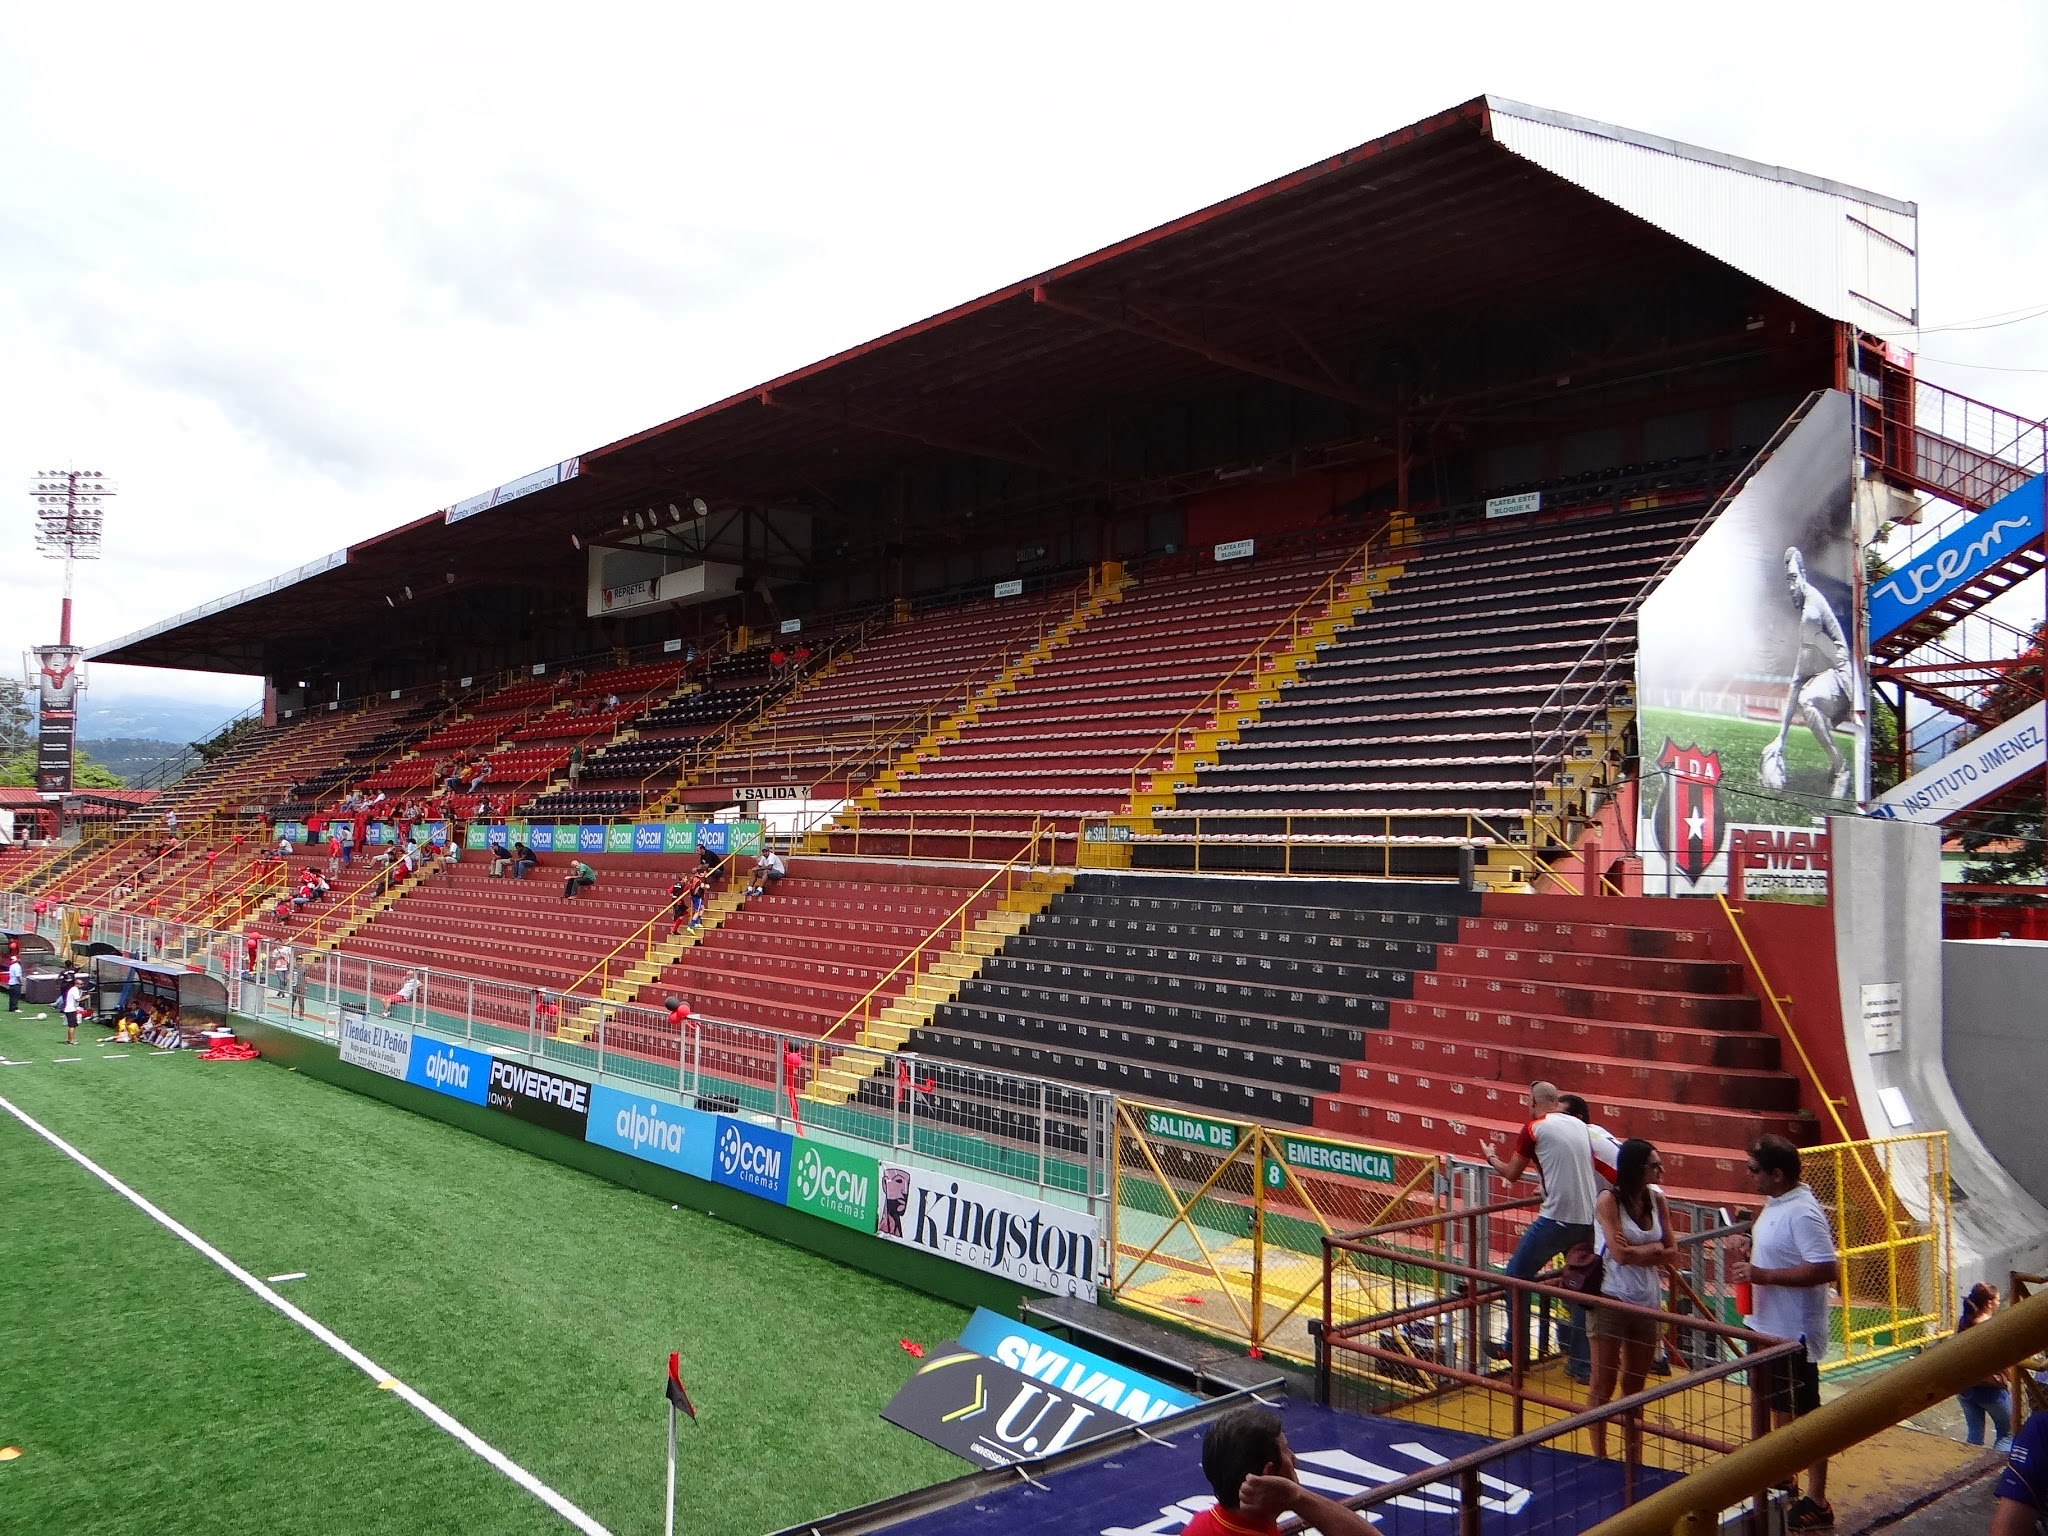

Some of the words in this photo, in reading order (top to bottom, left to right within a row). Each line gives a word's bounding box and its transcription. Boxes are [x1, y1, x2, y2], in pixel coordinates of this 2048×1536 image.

[1490, 498, 1516, 507] PLATEA
[1518, 494, 1536, 502] ESTE
[1494, 504, 1523, 514] BLOQUE
[1218, 544, 1236, 552] PLATEA
[1222, 550, 1242, 558] BLOQUE
[614, 582, 646, 599] REPRETEL
[1902, 764, 1978, 816] INSTITUTO
[1978, 726, 2044, 774] JIMENEZ
[745, 788, 797, 800] SALIDA
[474, 832, 485, 842] CCM
[494, 832, 506, 843] CCM
[538, 832, 552, 844] CCM
[563, 833, 576, 844] CCM
[588, 833, 603, 845] CCM
[616, 832, 632, 845] CCM
[644, 832, 662, 845] CCM
[676, 832, 692, 845] CCM
[706, 832, 724, 845] CCM
[741, 833, 759, 846] CCM
[345, 1019, 371, 1044] Tiendas
[373, 1027, 382, 1046] El
[383, 1030, 408, 1054] Peñón
[1100, 1030, 1108, 1038] 152
[1356, 1068, 1368, 1079] 142
[426, 1049, 468, 1088] alpina
[490, 1061, 588, 1113] POWERADE
[974, 1040, 982, 1050] 103
[1097, 1061, 1107, 1070] 109
[1169, 1074, 1178, 1083] 112
[1193, 1078, 1203, 1088] 113
[1244, 1087, 1254, 1097] 115
[1387, 1111, 1400, 1122] 120
[616, 1103, 682, 1153] alpina
[1150, 1114, 1205, 1141] SALIDA
[1210, 1126, 1232, 1148] DE
[740, 1142, 781, 1180] CCM
[1288, 1142, 1391, 1178] EMERGENCIA
[740, 1171, 779, 1191] cinemas
[1269, 1165, 1280, 1184] 8
[821, 1165, 868, 1207] CCM
[821, 1197, 865, 1220] cinemas
[912, 1182, 1093, 1282] Kingston
[943, 1238, 1095, 1300] TECHNOLOGY
